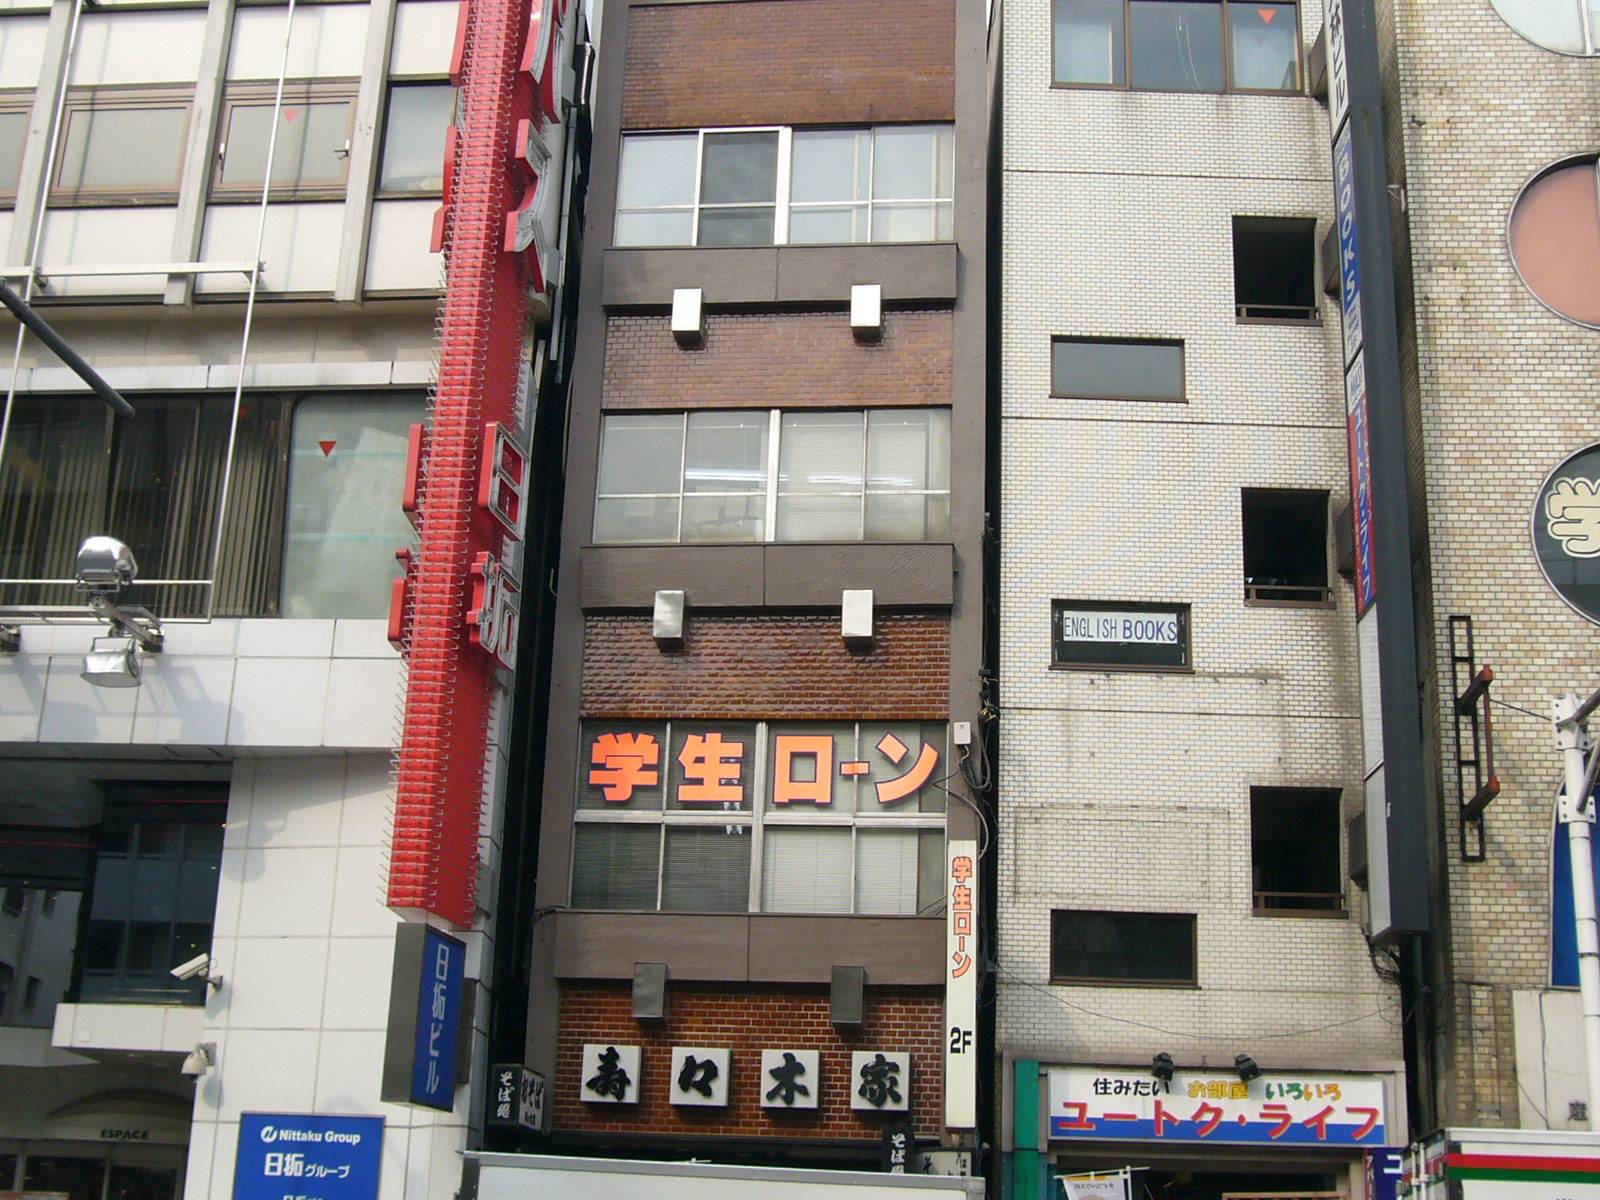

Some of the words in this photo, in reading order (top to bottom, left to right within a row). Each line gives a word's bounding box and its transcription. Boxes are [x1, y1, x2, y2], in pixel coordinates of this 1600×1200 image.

[1340, 152, 1355, 302] BOOKS
[1064, 617, 1117, 639] ENGLISH
[1123, 619, 1177, 642] BOOKS
[588, 732, 939, 804] 学生ローン
[952, 856, 972, 979] 学生ローン
[950, 1026, 972, 1054] 2F
[1093, 1078, 1170, 1096] 住みたい
[1187, 1080, 1249, 1099] お部屋
[1265, 1082, 1342, 1101] いろいろ
[1058, 1099, 1380, 1141] ユートク・ライフ
[101, 1129, 150, 1140] ESPACE
[280, 1130, 323, 1142] Nittaku
[324, 1131, 361, 1146] Group
